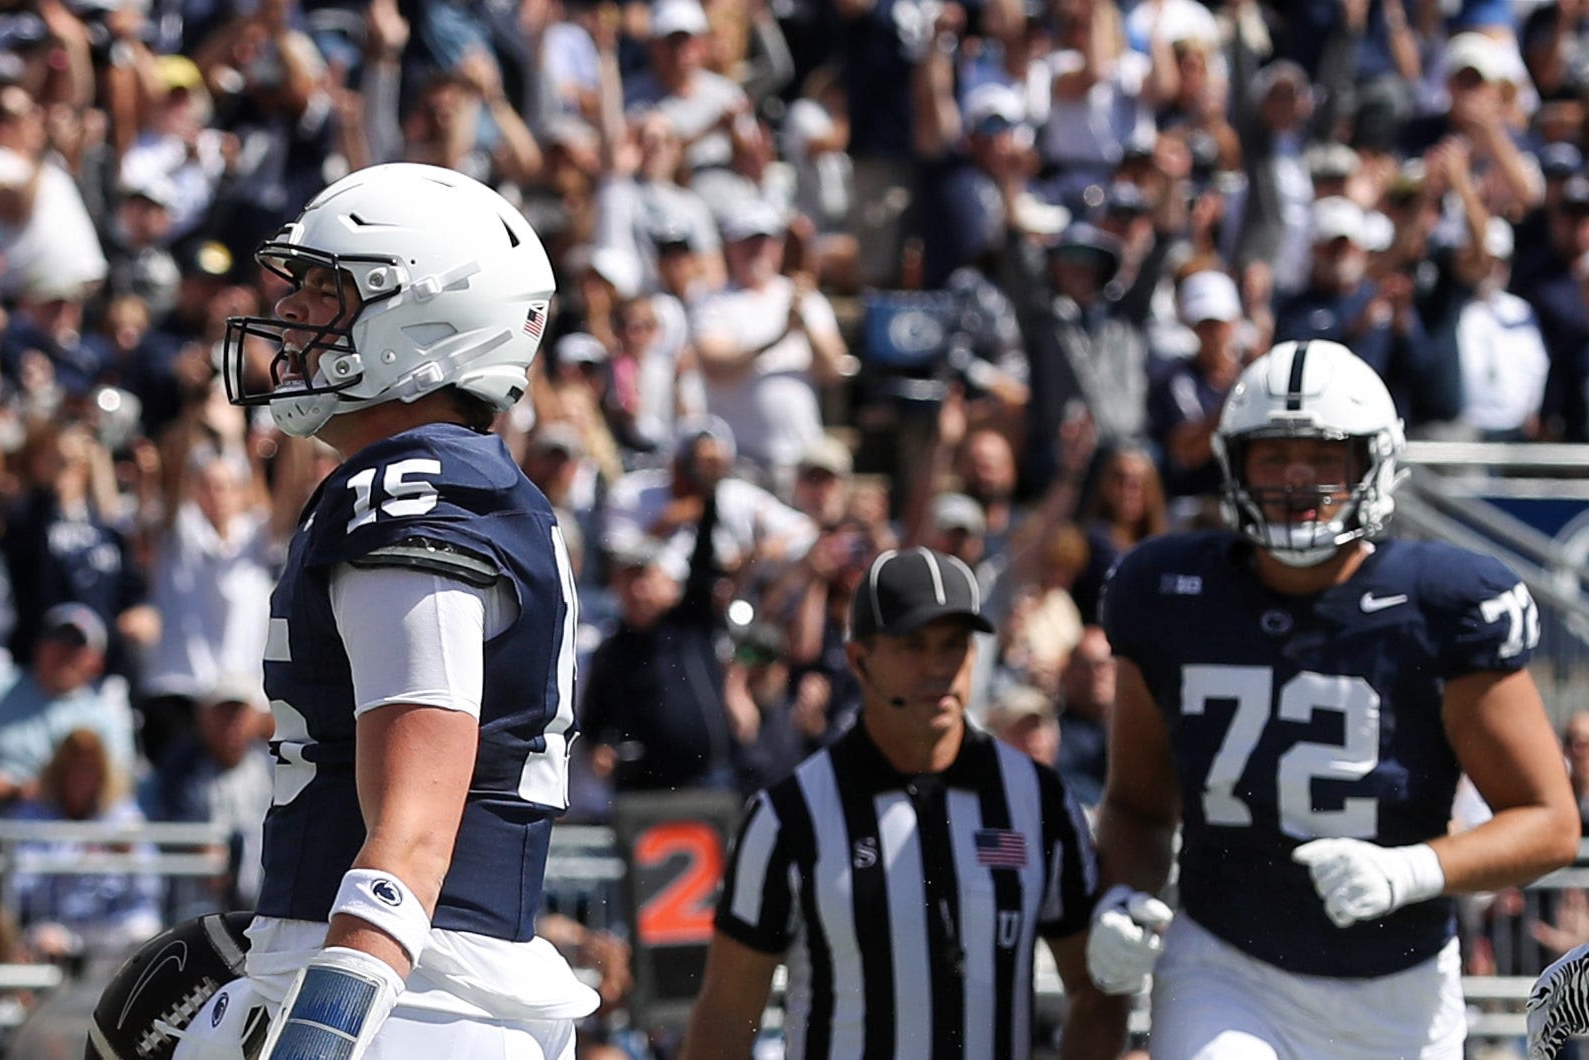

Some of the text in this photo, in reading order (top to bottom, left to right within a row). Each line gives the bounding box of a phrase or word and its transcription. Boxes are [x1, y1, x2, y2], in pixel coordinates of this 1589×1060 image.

[347, 459, 441, 534] 15
[1181, 664, 1381, 840] 72
[634, 821, 723, 945] 2
[853, 837, 878, 868] S
[998, 912, 1021, 948] U
